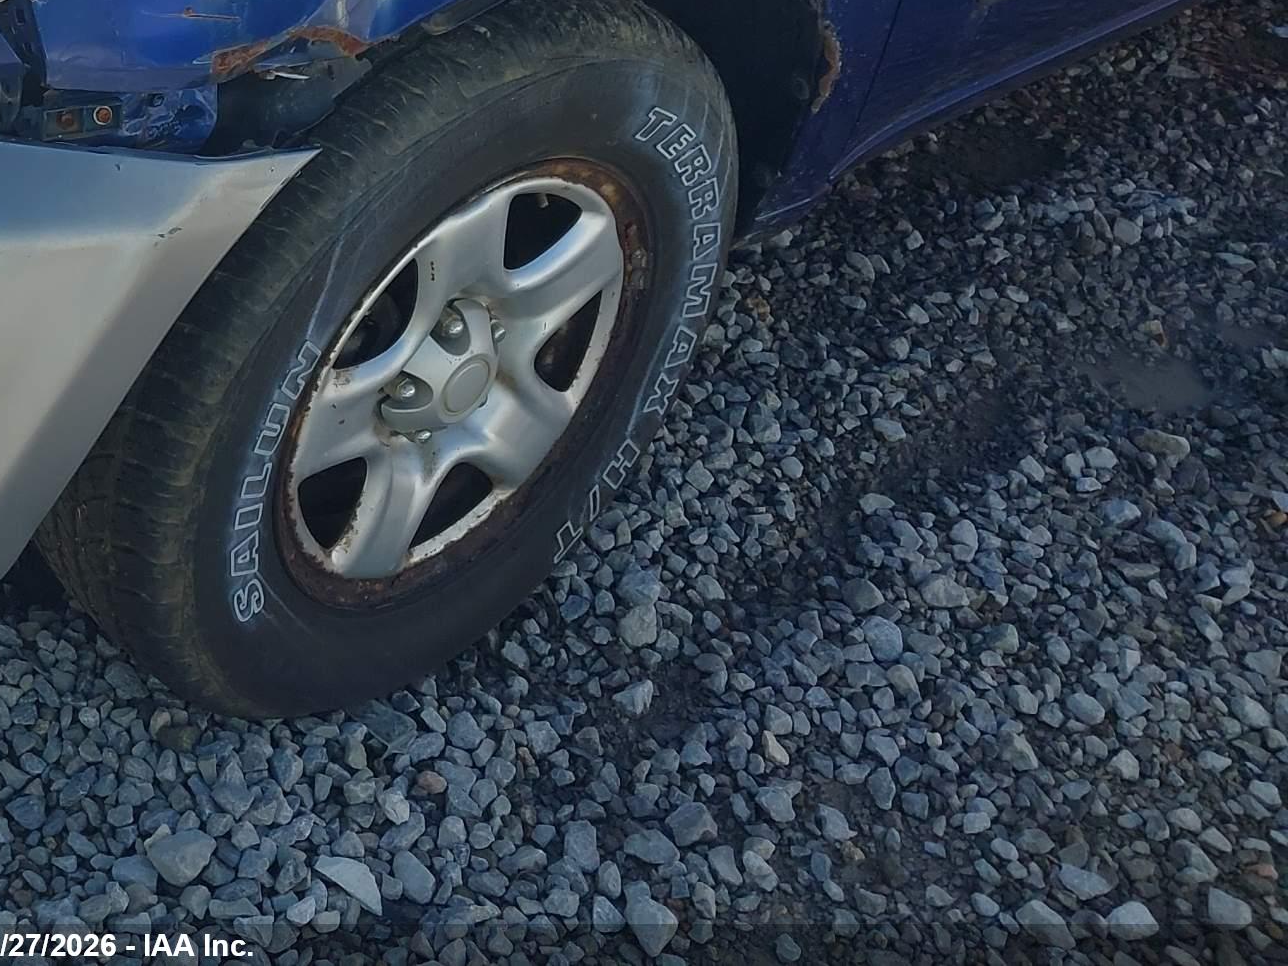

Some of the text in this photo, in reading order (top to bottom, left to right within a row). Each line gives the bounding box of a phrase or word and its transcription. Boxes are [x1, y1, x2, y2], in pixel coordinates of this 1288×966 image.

[229, 339, 323, 623] SAILUN
[553, 106, 721, 564] TERRAMAX H/T
